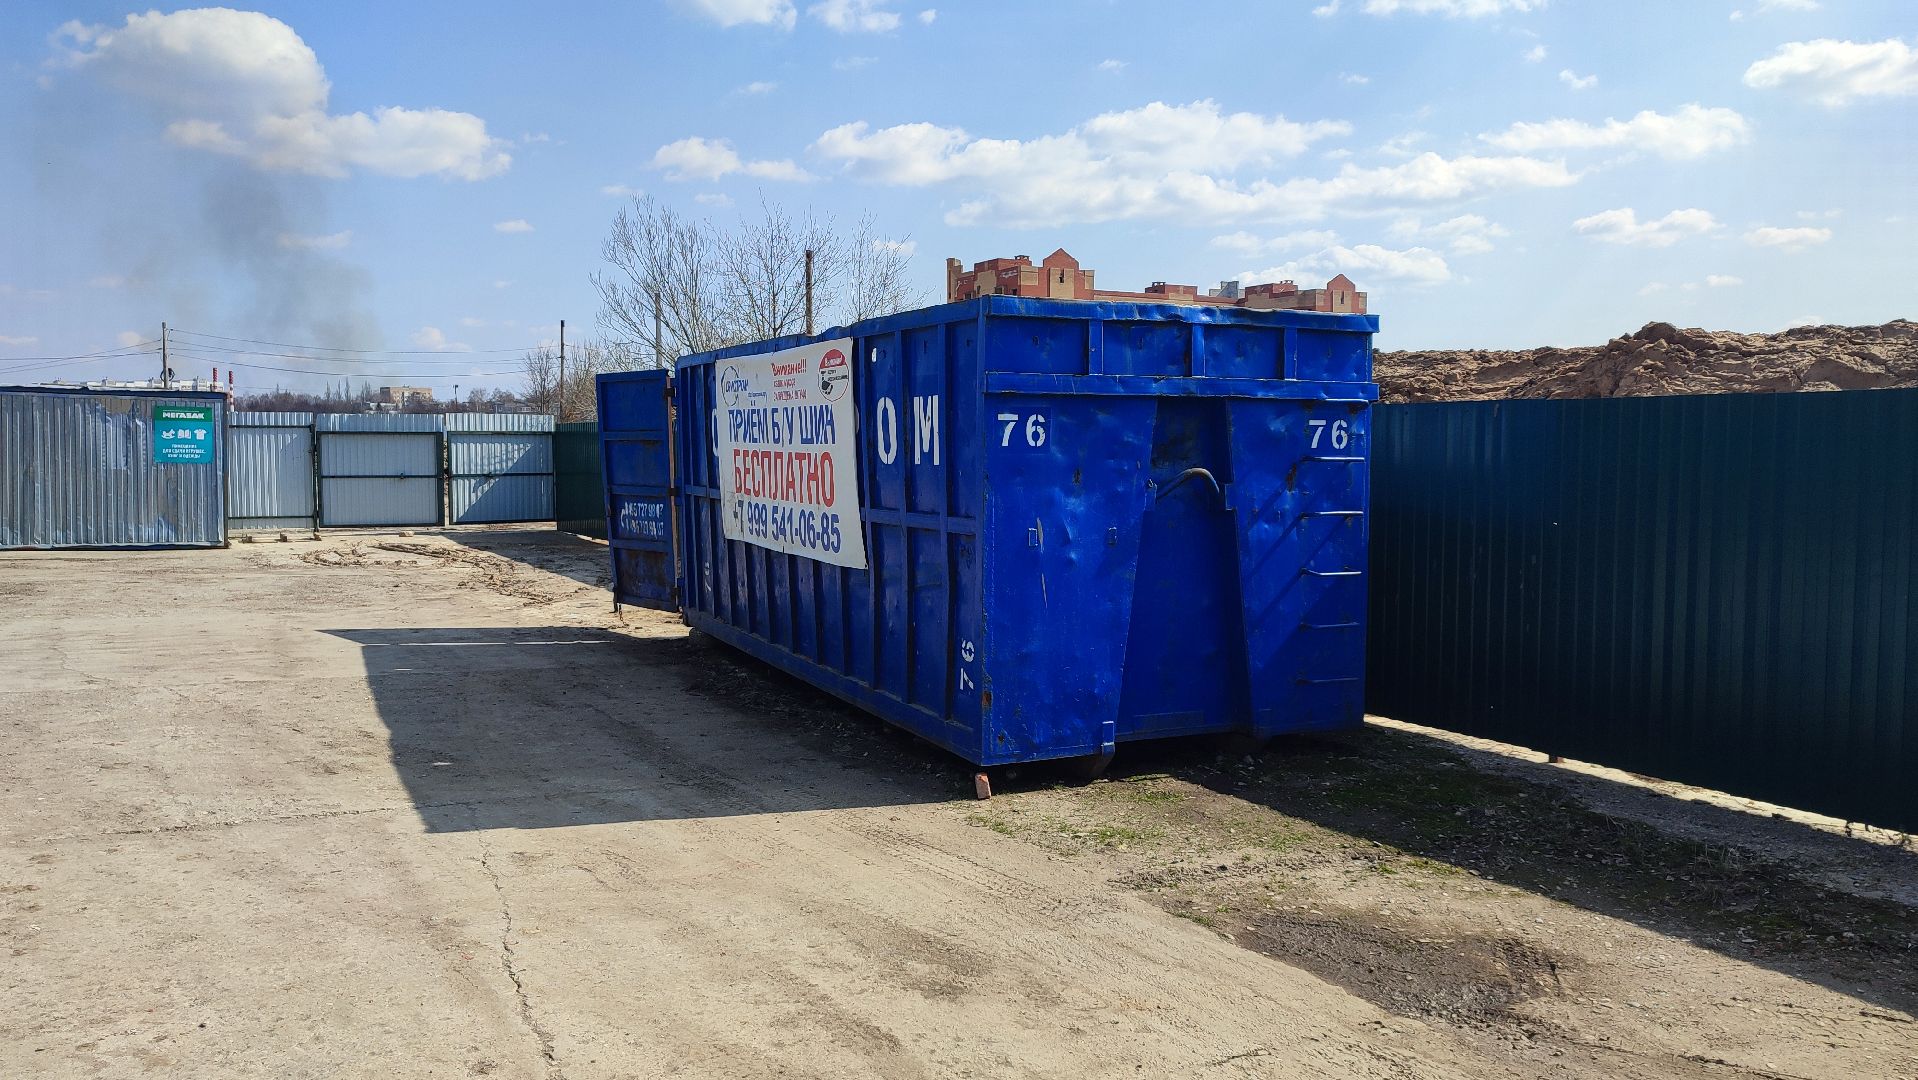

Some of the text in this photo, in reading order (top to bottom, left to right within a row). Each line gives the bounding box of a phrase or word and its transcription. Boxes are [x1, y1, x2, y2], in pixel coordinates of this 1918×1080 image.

[728, 400, 836, 447] ПРИЁМ Б/У ШИН
[997, 413, 1046, 447] 76
[1308, 419, 1348, 450] 76
[733, 449, 835, 508] БЕСПЛАТНО
[732, 500, 841, 554] +7 999 541-06-85
[960, 639, 975, 691] 76
